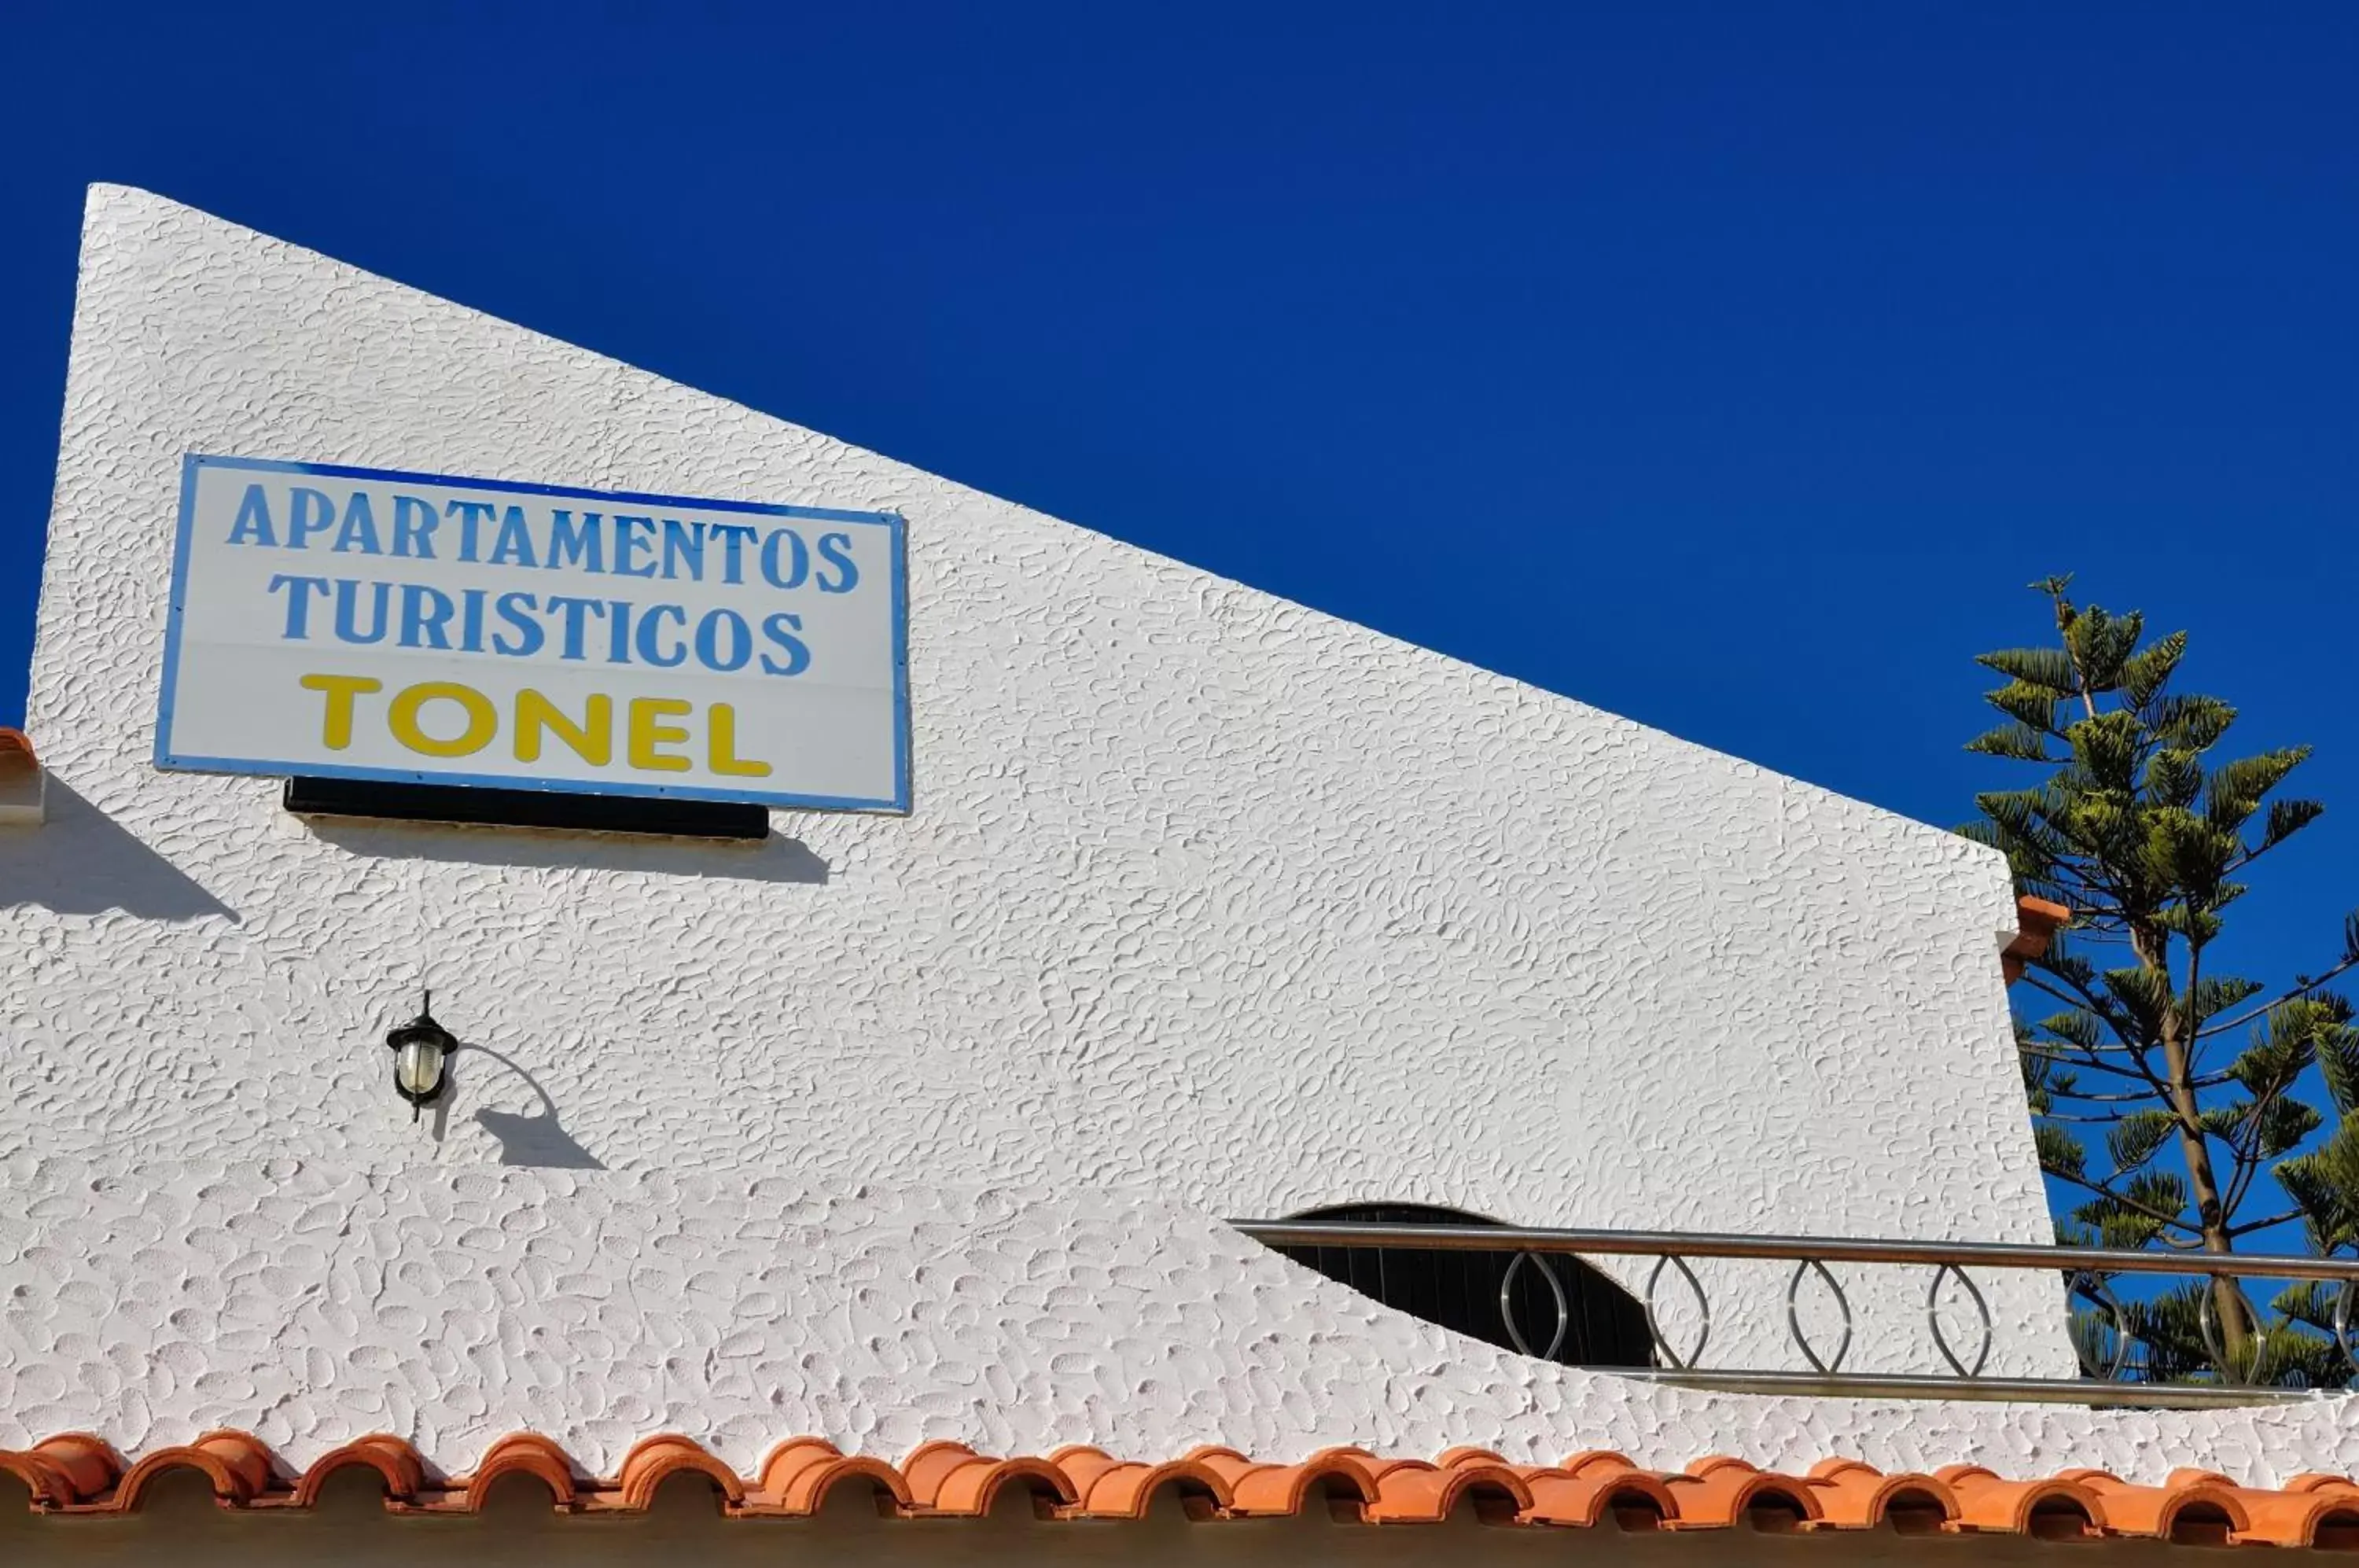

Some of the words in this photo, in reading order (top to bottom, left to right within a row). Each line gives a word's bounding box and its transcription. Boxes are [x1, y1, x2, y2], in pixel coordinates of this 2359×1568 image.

[226, 484, 859, 594] APARTAMENTOS
[268, 574, 811, 676] TURISTICOS
[300, 673, 774, 778] TONEL
